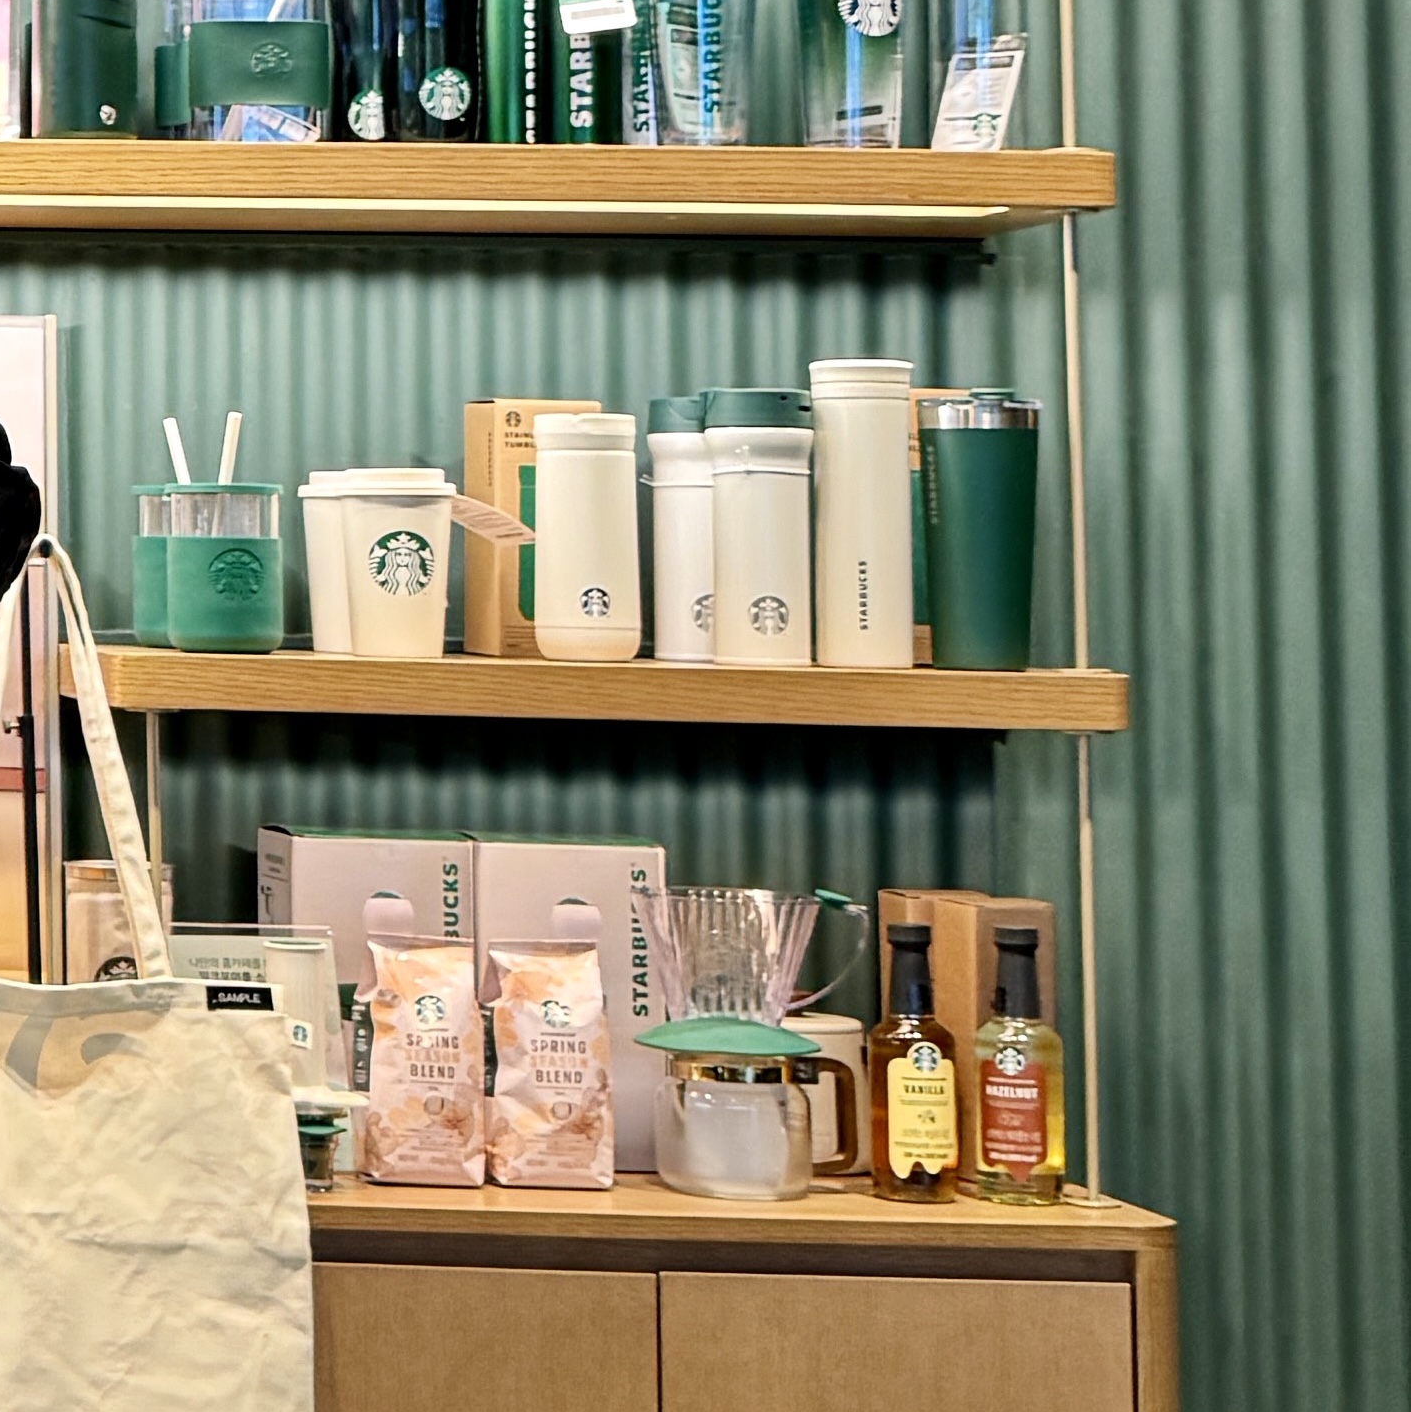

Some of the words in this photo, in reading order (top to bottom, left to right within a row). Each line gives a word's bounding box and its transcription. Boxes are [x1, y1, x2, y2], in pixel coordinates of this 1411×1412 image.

[570, 34, 594, 128] STARB
[505, 441, 536, 449] TUMBL
[858, 561, 868, 630] STARBUCKS
[442, 863, 459, 938] BUCKS
[631, 869, 649, 1017] STARBUKS
[217, 992, 262, 1004] SAMPLE
[406, 1033, 459, 1050] SPING
[530, 1039, 587, 1054] SPRING
[410, 1064, 455, 1079] BLEND
[535, 1070, 583, 1084] BLEND
[903, 1084, 945, 1095] VANILLA
